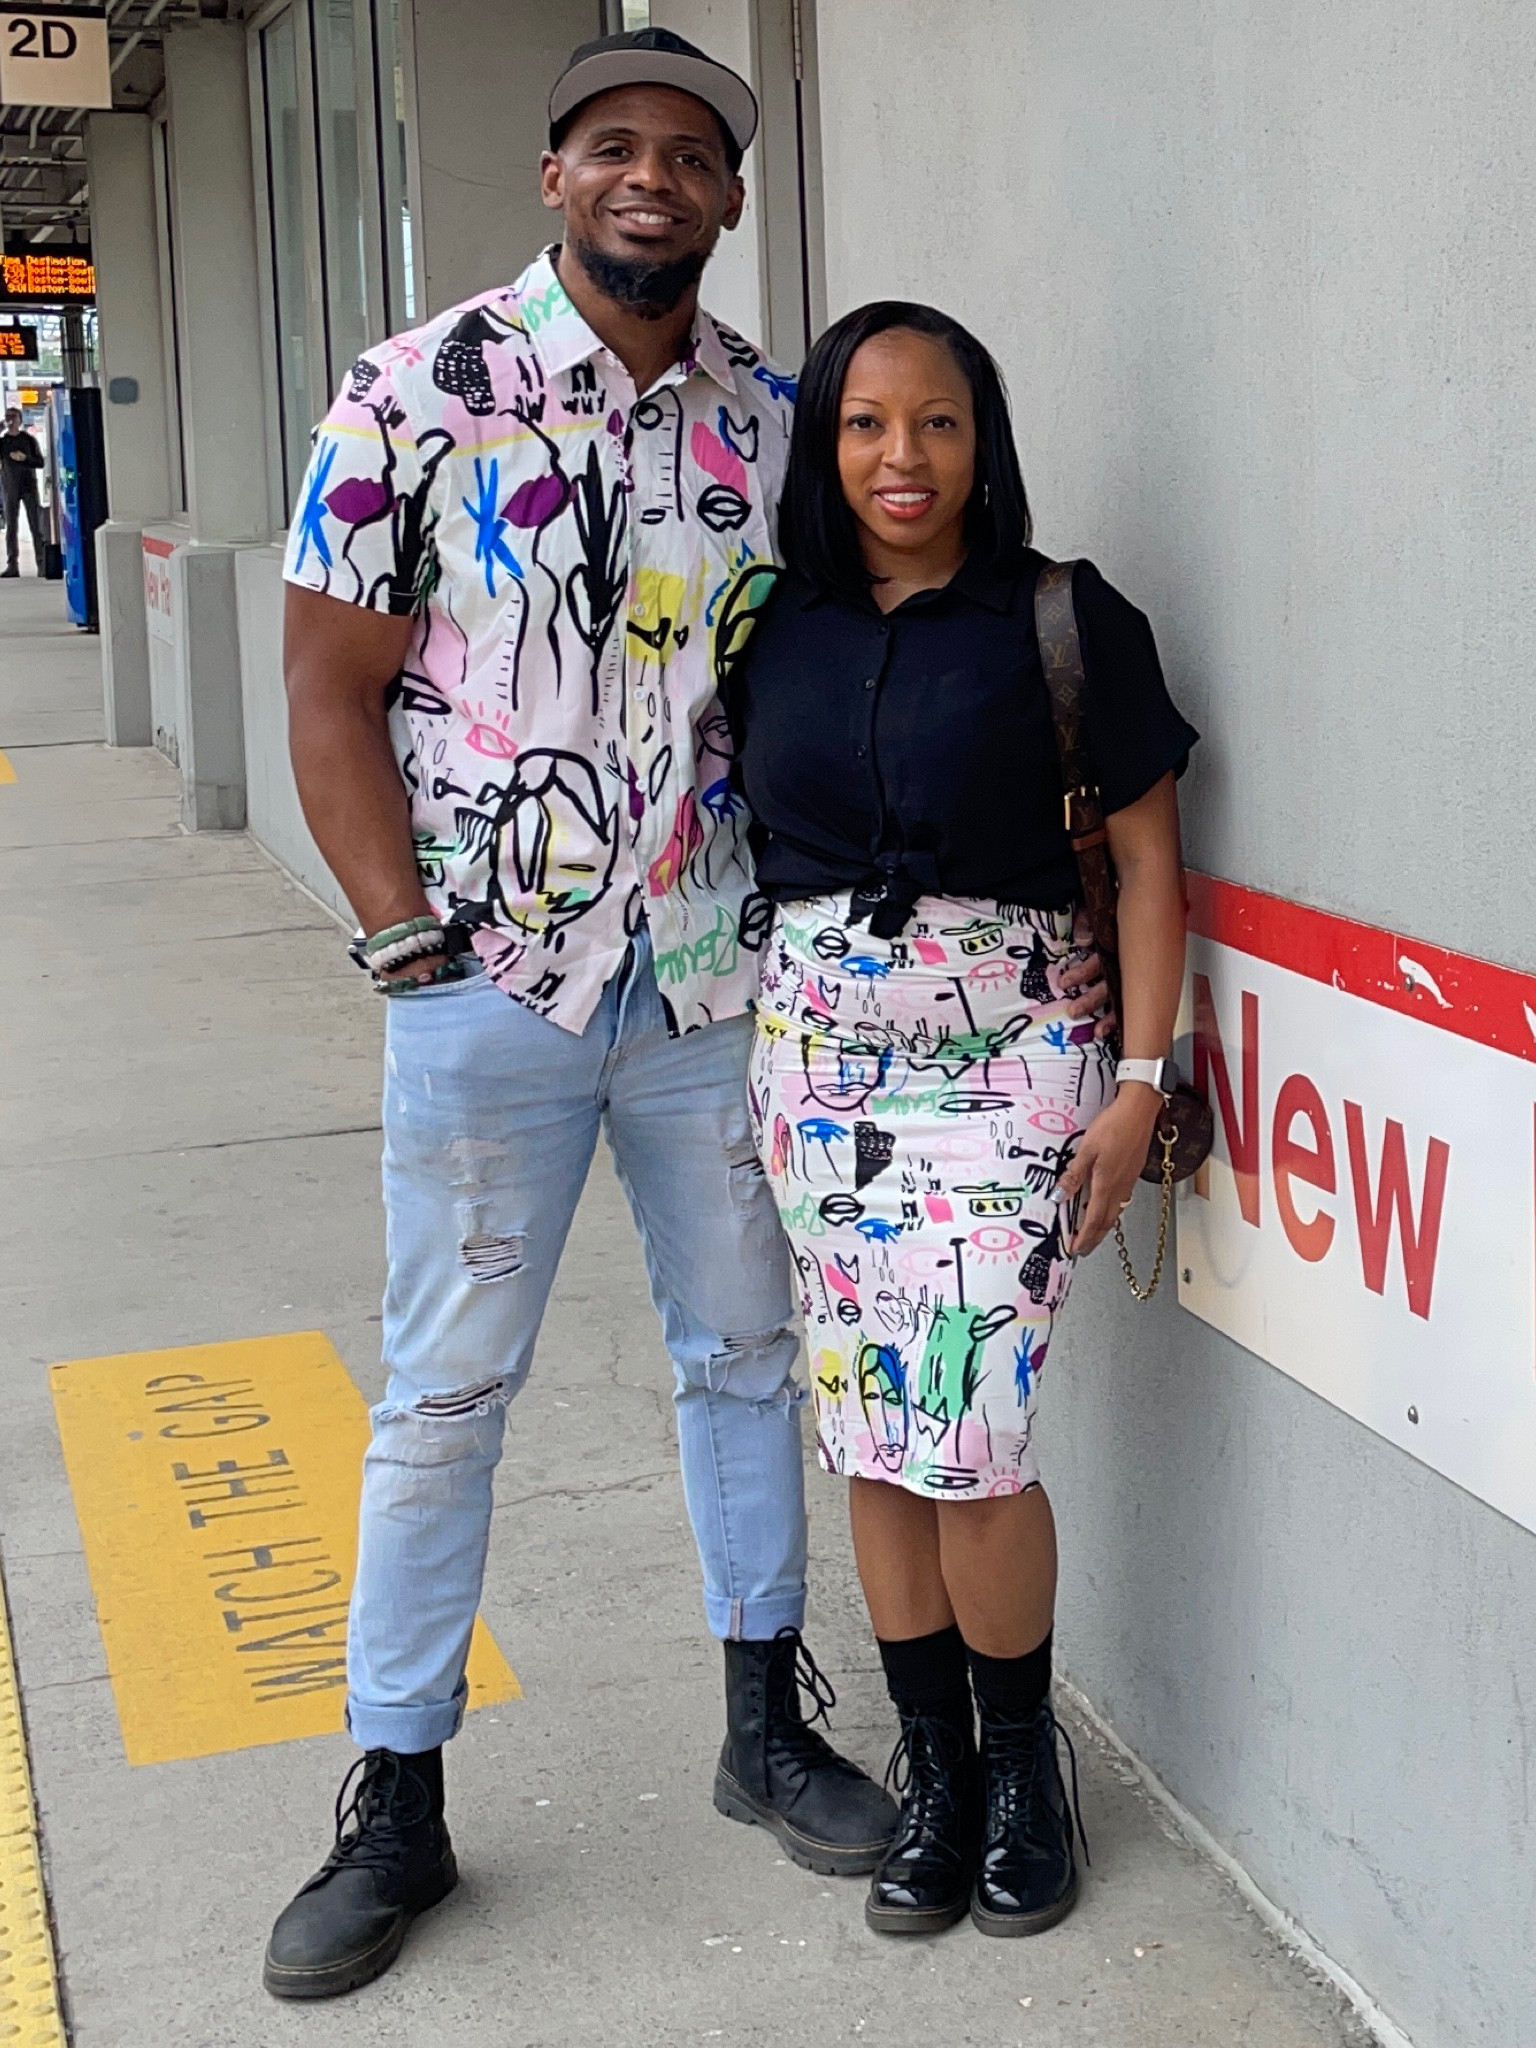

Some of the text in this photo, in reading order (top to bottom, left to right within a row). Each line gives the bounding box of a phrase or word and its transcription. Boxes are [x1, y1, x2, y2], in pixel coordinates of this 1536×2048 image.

[8, 18, 77, 59] 2D
[1193, 973, 1451, 1321] New
[145, 1374, 352, 1703] WATCH THE GAP
